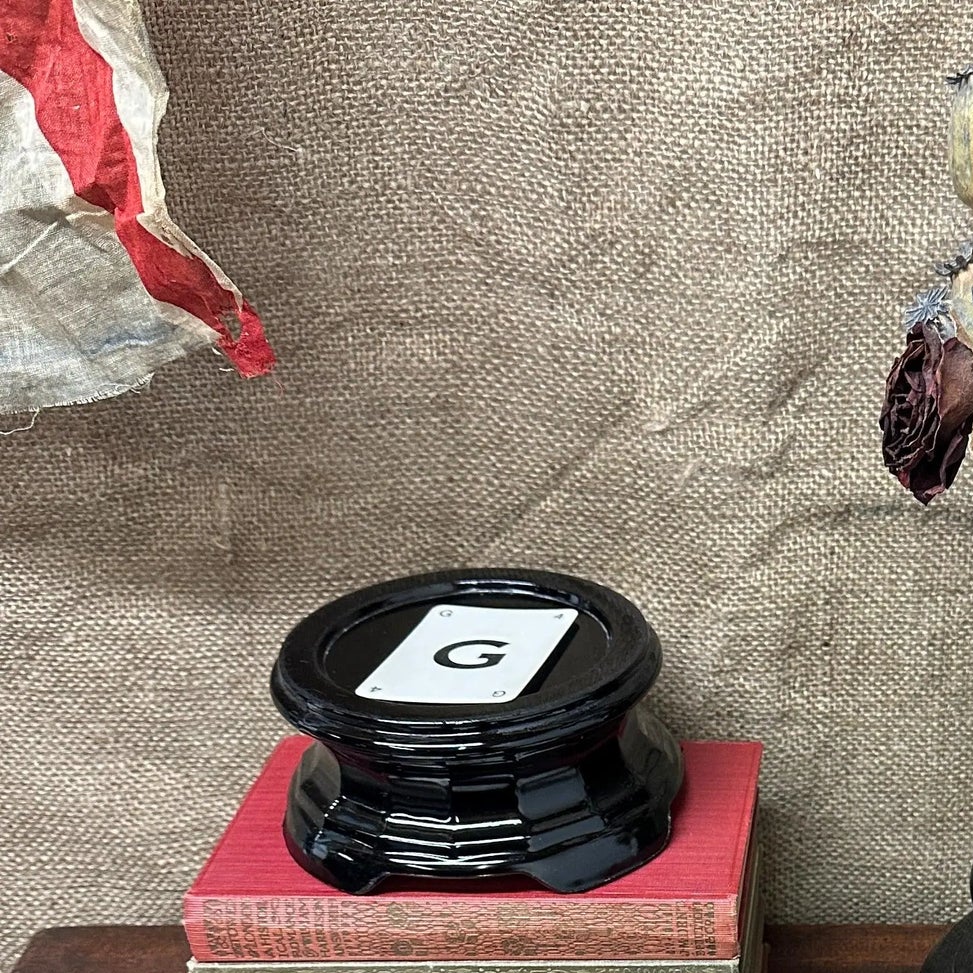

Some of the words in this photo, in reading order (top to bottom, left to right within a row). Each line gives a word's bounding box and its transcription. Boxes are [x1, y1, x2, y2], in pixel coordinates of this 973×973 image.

[439, 608, 453, 618] G
[554, 612, 565, 621] 4
[433, 639, 510, 670] G
[369, 685, 382, 694] 4
[491, 689, 506, 699] G
[285, 898, 303, 958] ROMANCE
[313, 899, 331, 958] HARRISON
